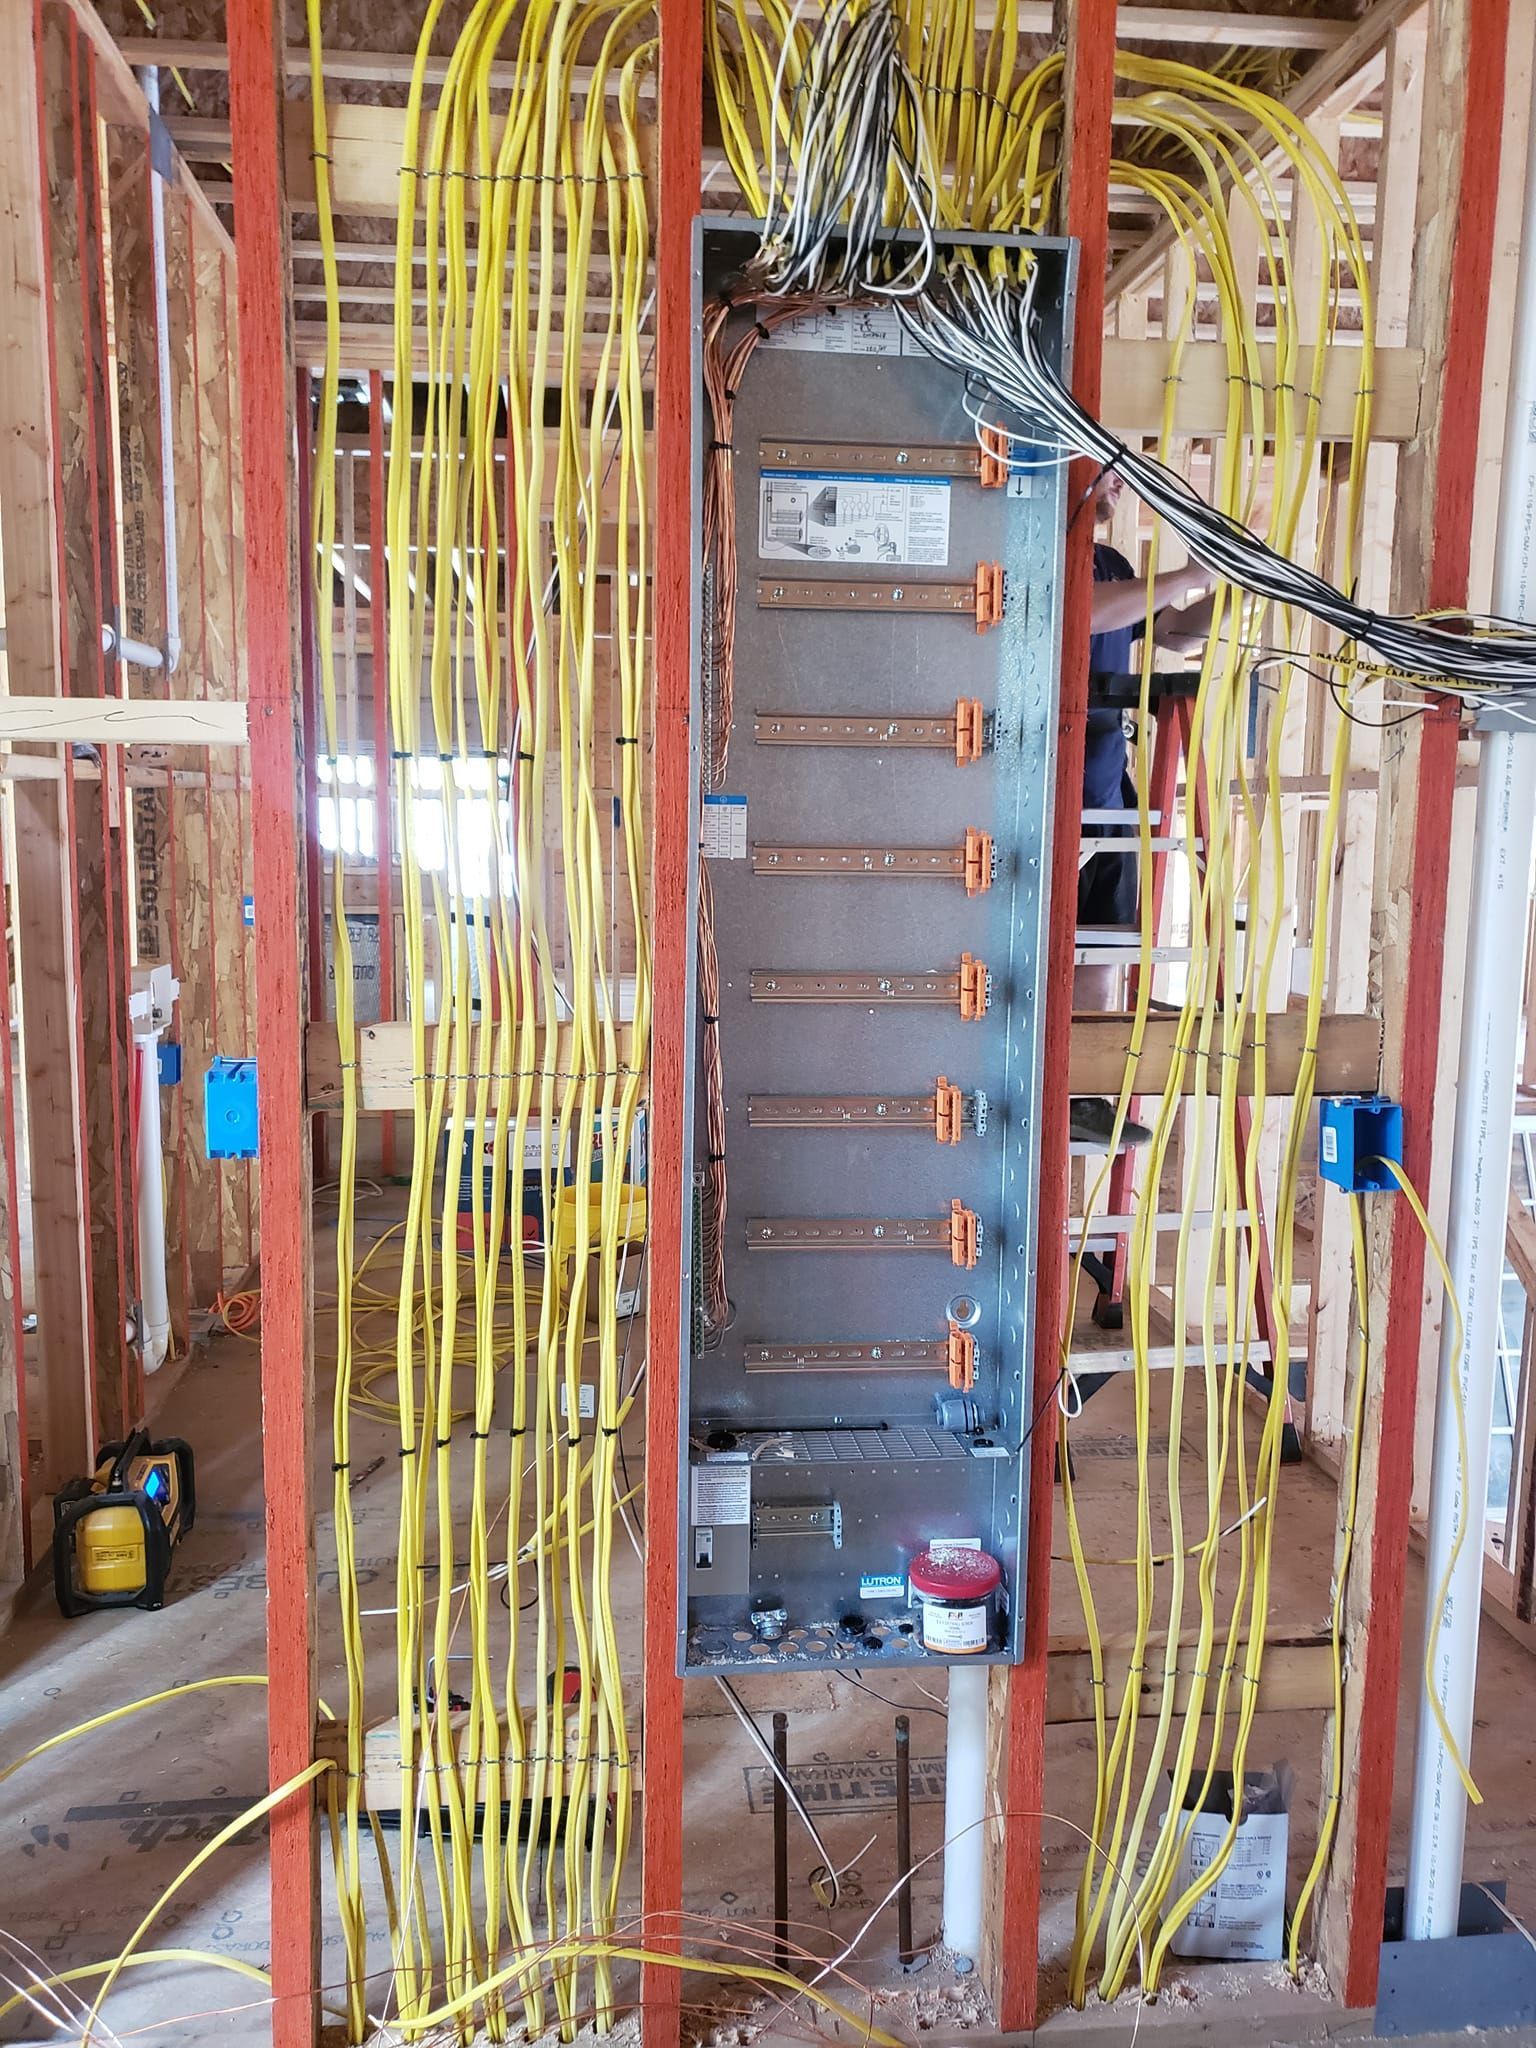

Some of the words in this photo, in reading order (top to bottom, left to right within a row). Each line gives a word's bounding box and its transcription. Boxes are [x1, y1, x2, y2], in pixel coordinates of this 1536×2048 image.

[1481, 1070, 1491, 1114] CHARLOTTE
[861, 1576, 902, 1586] LUTRON
[762, 1776, 945, 1805] IFETIME
